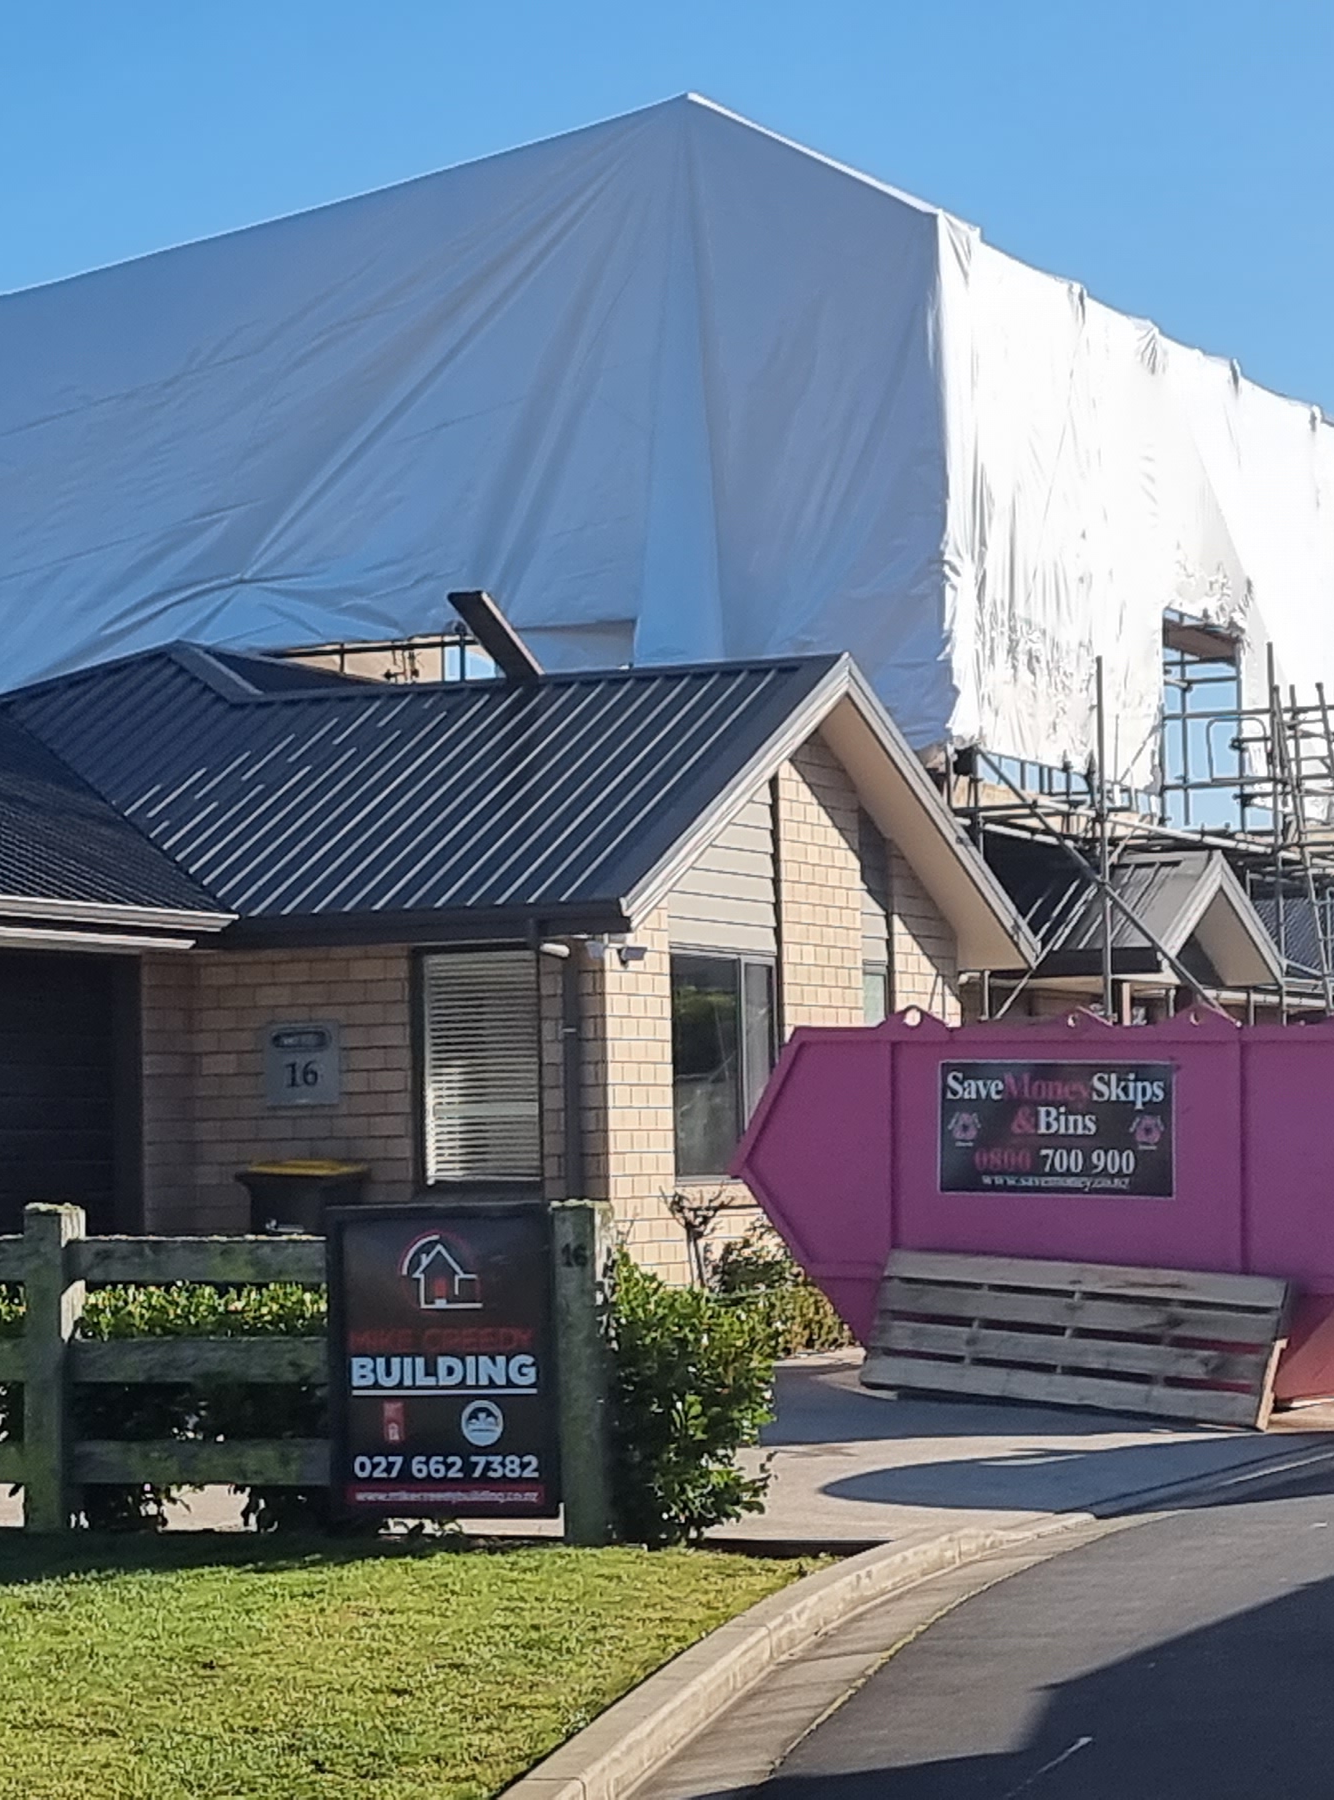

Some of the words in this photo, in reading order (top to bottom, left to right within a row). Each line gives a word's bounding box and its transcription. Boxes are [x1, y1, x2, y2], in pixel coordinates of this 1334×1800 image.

[286, 1060, 318, 1088] 16
[974, 1149, 1031, 1172] 0800
[1040, 1149, 1083, 1172] 700
[1091, 1149, 1135, 1174] 900
[561, 1243, 588, 1268] 16
[351, 1354, 537, 1387] BUILDING
[354, 1455, 403, 1478] 027
[411, 1455, 464, 1478] 662
[470, 1454, 539, 1478] 7382
